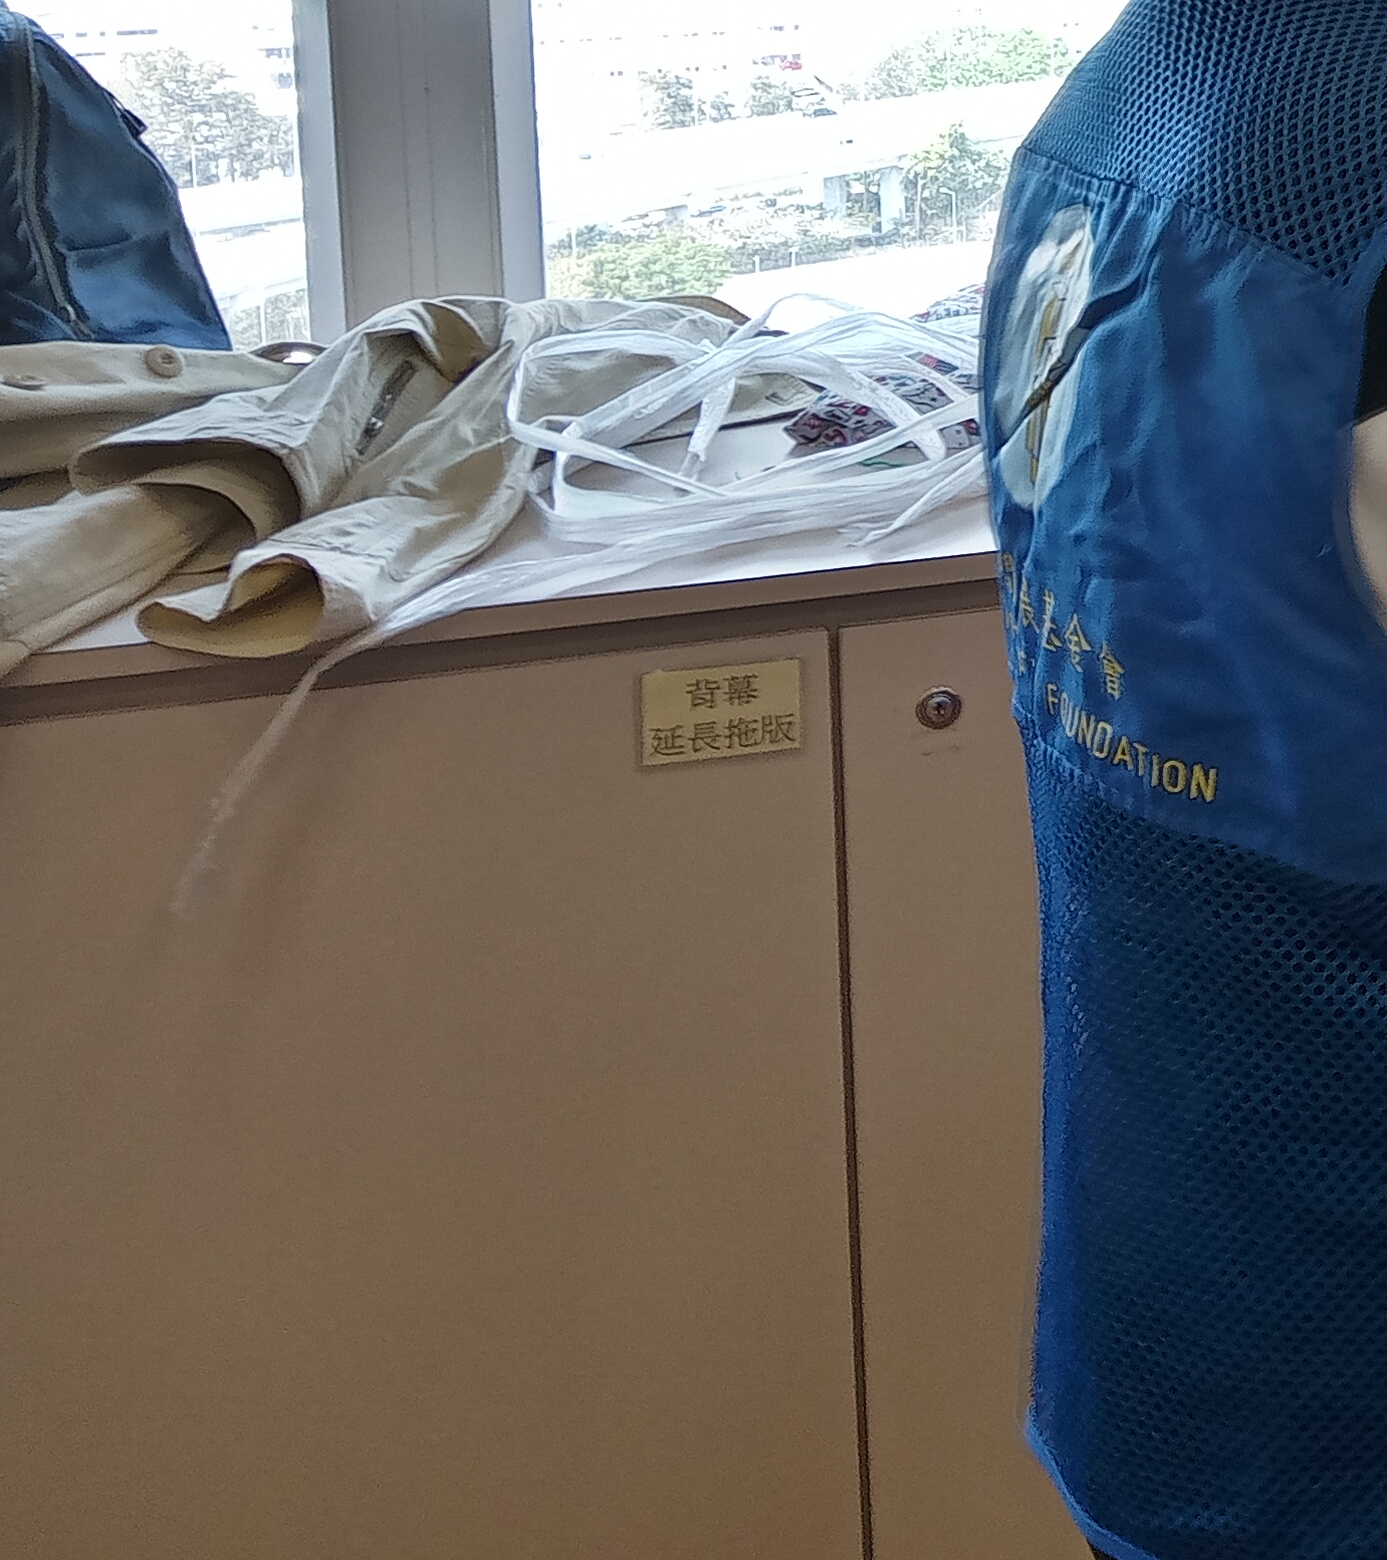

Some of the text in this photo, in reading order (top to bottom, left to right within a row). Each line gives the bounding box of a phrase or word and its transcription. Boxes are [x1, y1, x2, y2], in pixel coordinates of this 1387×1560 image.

[685, 673, 760, 709] 背幕
[648, 712, 797, 757] 延長拖版
[1045, 682, 1219, 803] FOUNDATION
